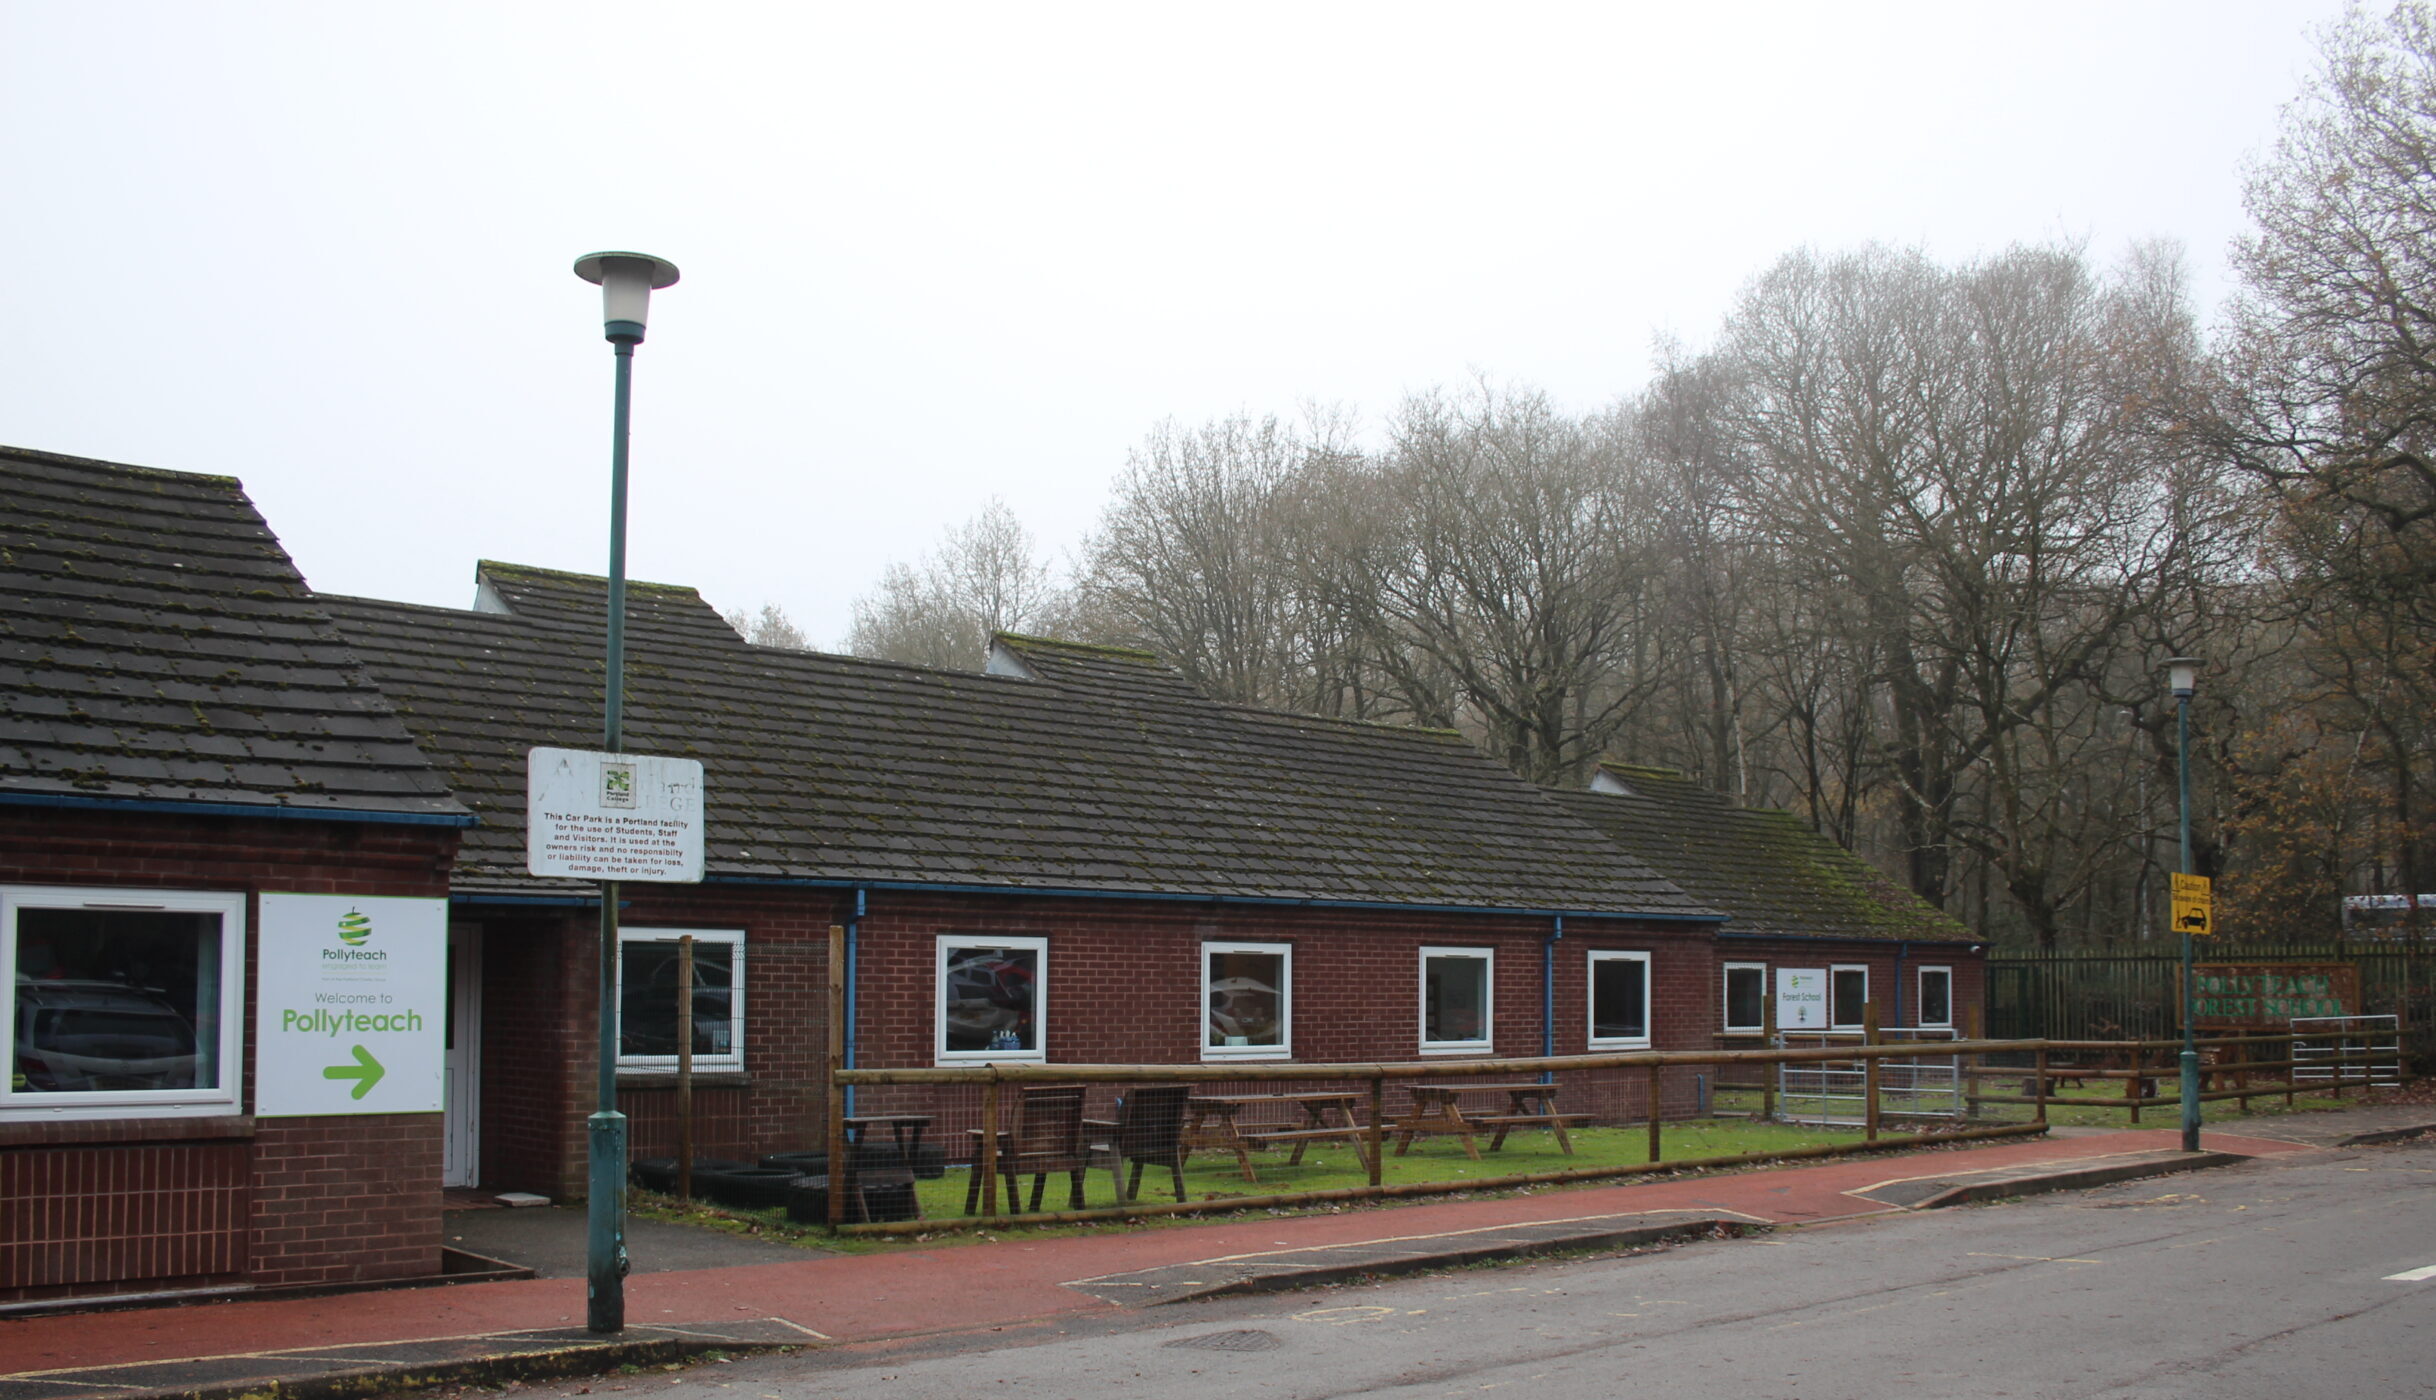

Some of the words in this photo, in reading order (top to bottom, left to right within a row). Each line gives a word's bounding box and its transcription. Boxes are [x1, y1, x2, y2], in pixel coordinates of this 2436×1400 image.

[544, 812, 563, 821] This
[605, 816, 612, 824] is
[623, 817, 658, 826] Portland
[660, 820, 688, 830] facility
[555, 823, 568, 831] for
[616, 827, 656, 837] Students,
[658, 829, 678, 837] Staff
[573, 834, 608, 843] Visitors.
[662, 839, 676, 847] the
[559, 853, 591, 863] liability
[624, 856, 648, 864] taken
[641, 867, 667, 876] injury.
[322, 948, 387, 962] Pollyteach
[315, 992, 376, 1004] Welcome
[381, 993, 393, 1004] to
[2262, 998, 2345, 1017] SCHOOL
[283, 1009, 423, 1038] Pollyteach
